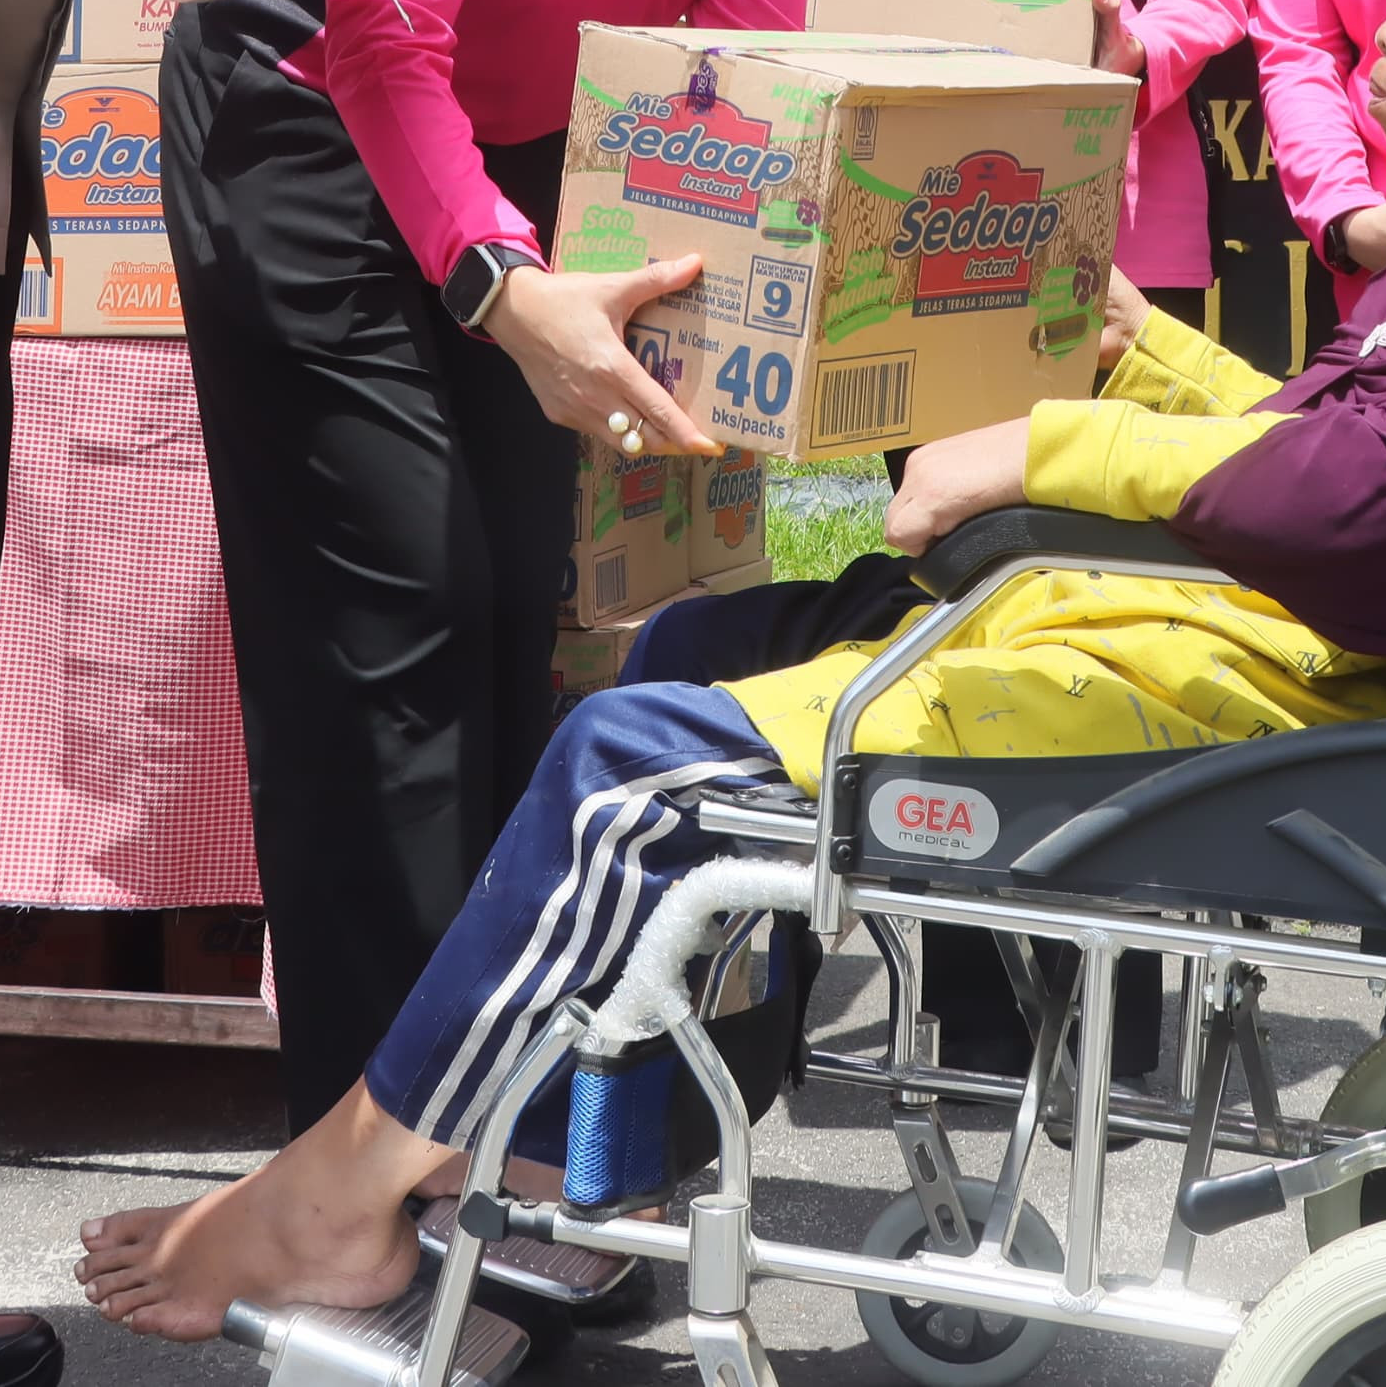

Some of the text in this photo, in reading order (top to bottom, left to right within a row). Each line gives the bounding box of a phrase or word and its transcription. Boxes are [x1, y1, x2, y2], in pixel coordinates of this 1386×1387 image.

[625, 91, 673, 120] Mie
[597, 111, 797, 193] Sedaap
[86, 182, 162, 205] Instan
[679, 172, 743, 200] Instant
[919, 167, 961, 198] Mie
[584, 209, 631, 231] Soto
[629, 191, 658, 206] JELAS
[661, 197, 697, 215] TERASA
[700, 205, 750, 226] SEDAPNYA
[65, 220, 112, 231] TERASA
[890, 190, 1064, 261] Sedaap
[564, 232, 645, 256] Madura
[127, 262, 159, 275] Instan
[755, 267, 806, 284] MAKSIMUM
[756, 261, 806, 277] TUMPUKAN
[963, 256, 1019, 281] Instant
[97, 282, 162, 310] AYAM
[694, 292, 742, 313] ALAM SEGAR
[763, 280, 792, 318] 9
[918, 295, 1023, 314] JELAS TERASA SEDAPNYA
[715, 343, 794, 417] 40
[712, 405, 786, 440] bks/packs
[707, 462, 763, 518] Sedaap
[896, 793, 976, 838] GEA
